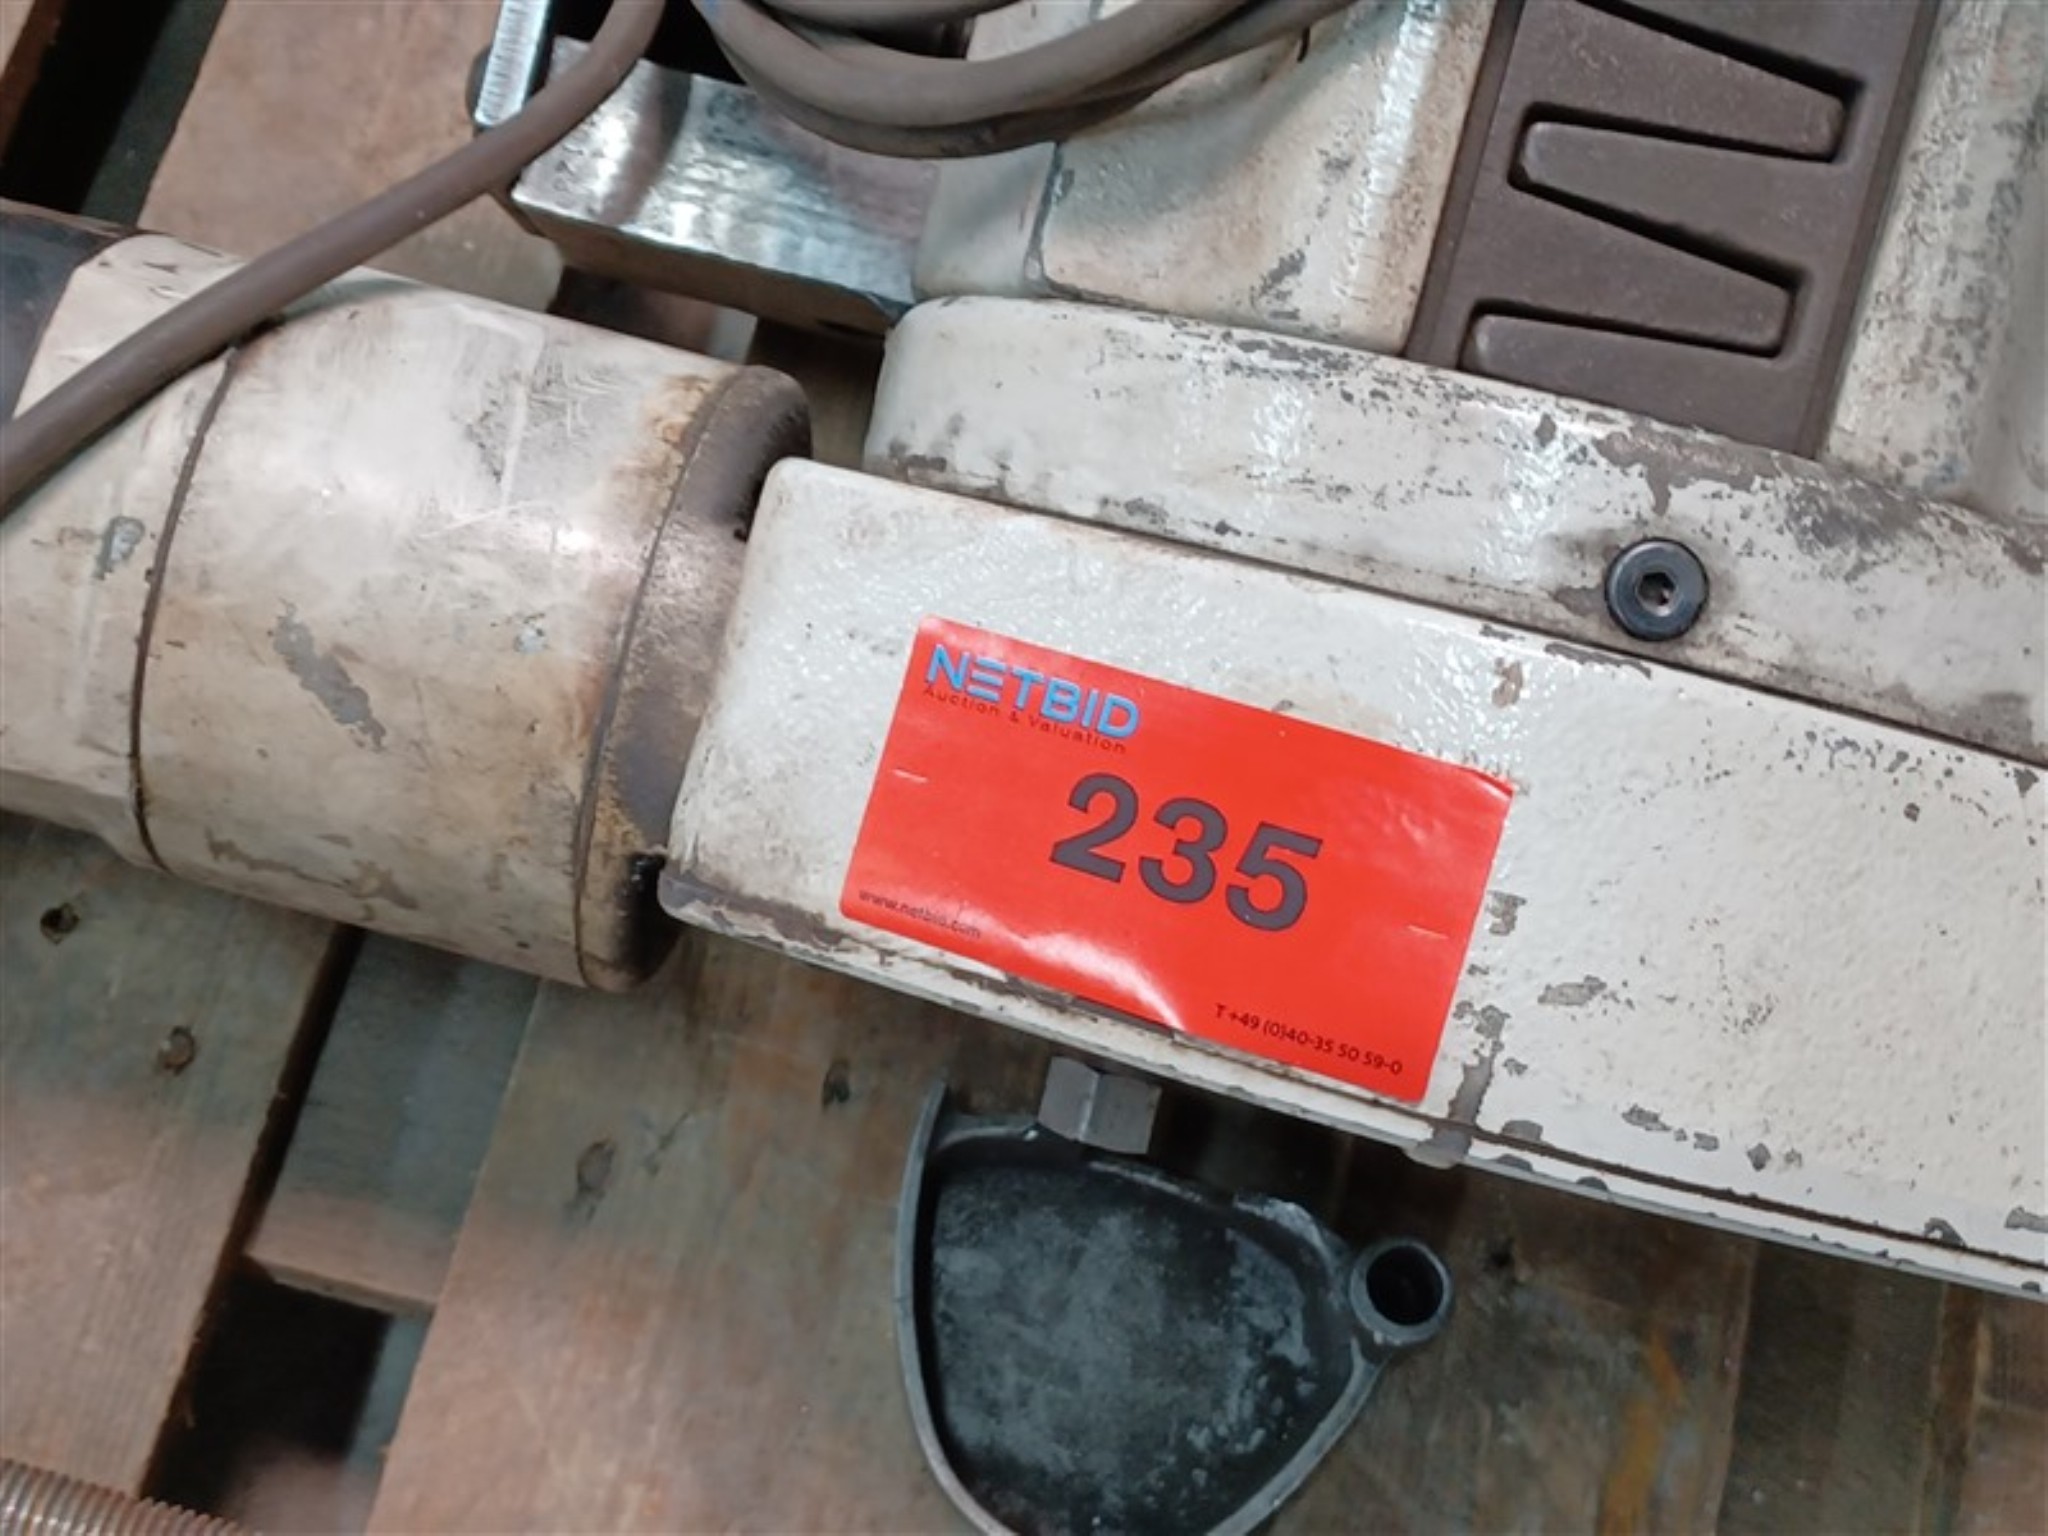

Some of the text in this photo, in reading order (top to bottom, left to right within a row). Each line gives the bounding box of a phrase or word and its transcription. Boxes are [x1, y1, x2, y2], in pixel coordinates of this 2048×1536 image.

[923, 684, 999, 717] Auction
[1030, 715, 1127, 754] Valuation
[926, 644, 1141, 738] NETBID
[1050, 772, 1323, 931] 235
[1215, 1003, 1403, 1076] T +49 (0)40-35 50 59-0
